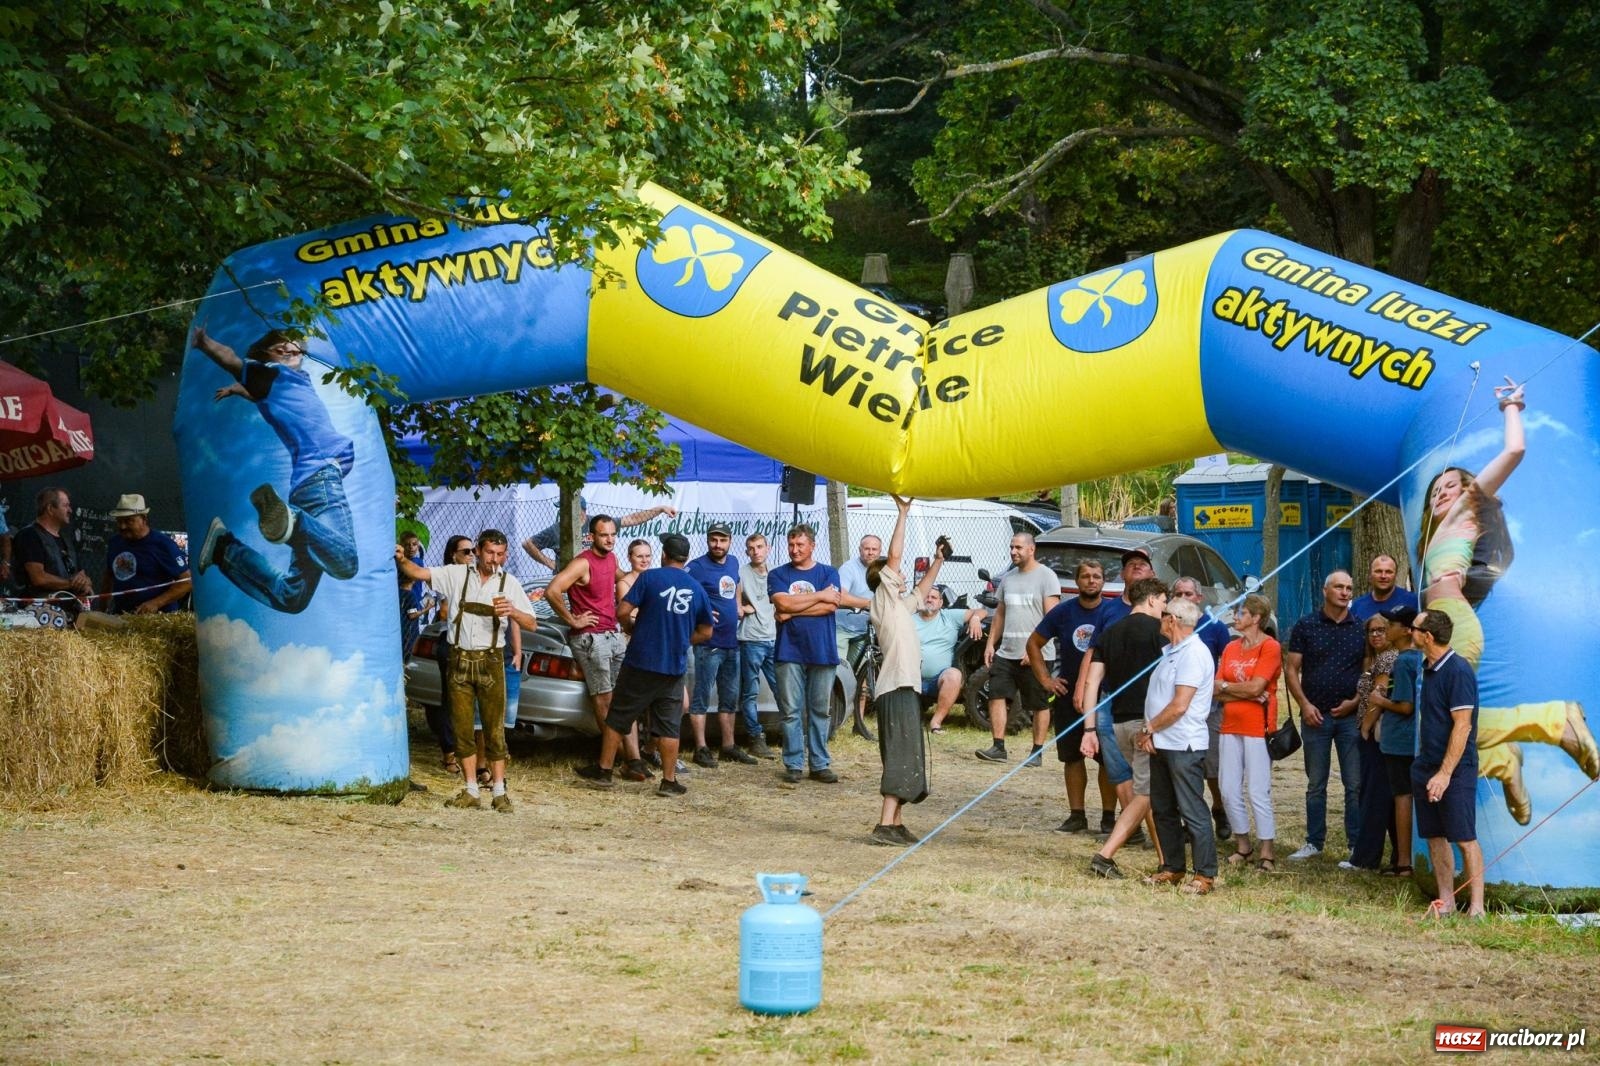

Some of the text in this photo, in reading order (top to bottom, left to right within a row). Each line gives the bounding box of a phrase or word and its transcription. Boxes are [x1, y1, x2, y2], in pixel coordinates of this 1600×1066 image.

[298, 217, 448, 264] Gmina
[1242, 247, 1491, 346] Gmina ludzi
[1213, 287, 1436, 389] aktywnych
[659, 586, 694, 615] 18
